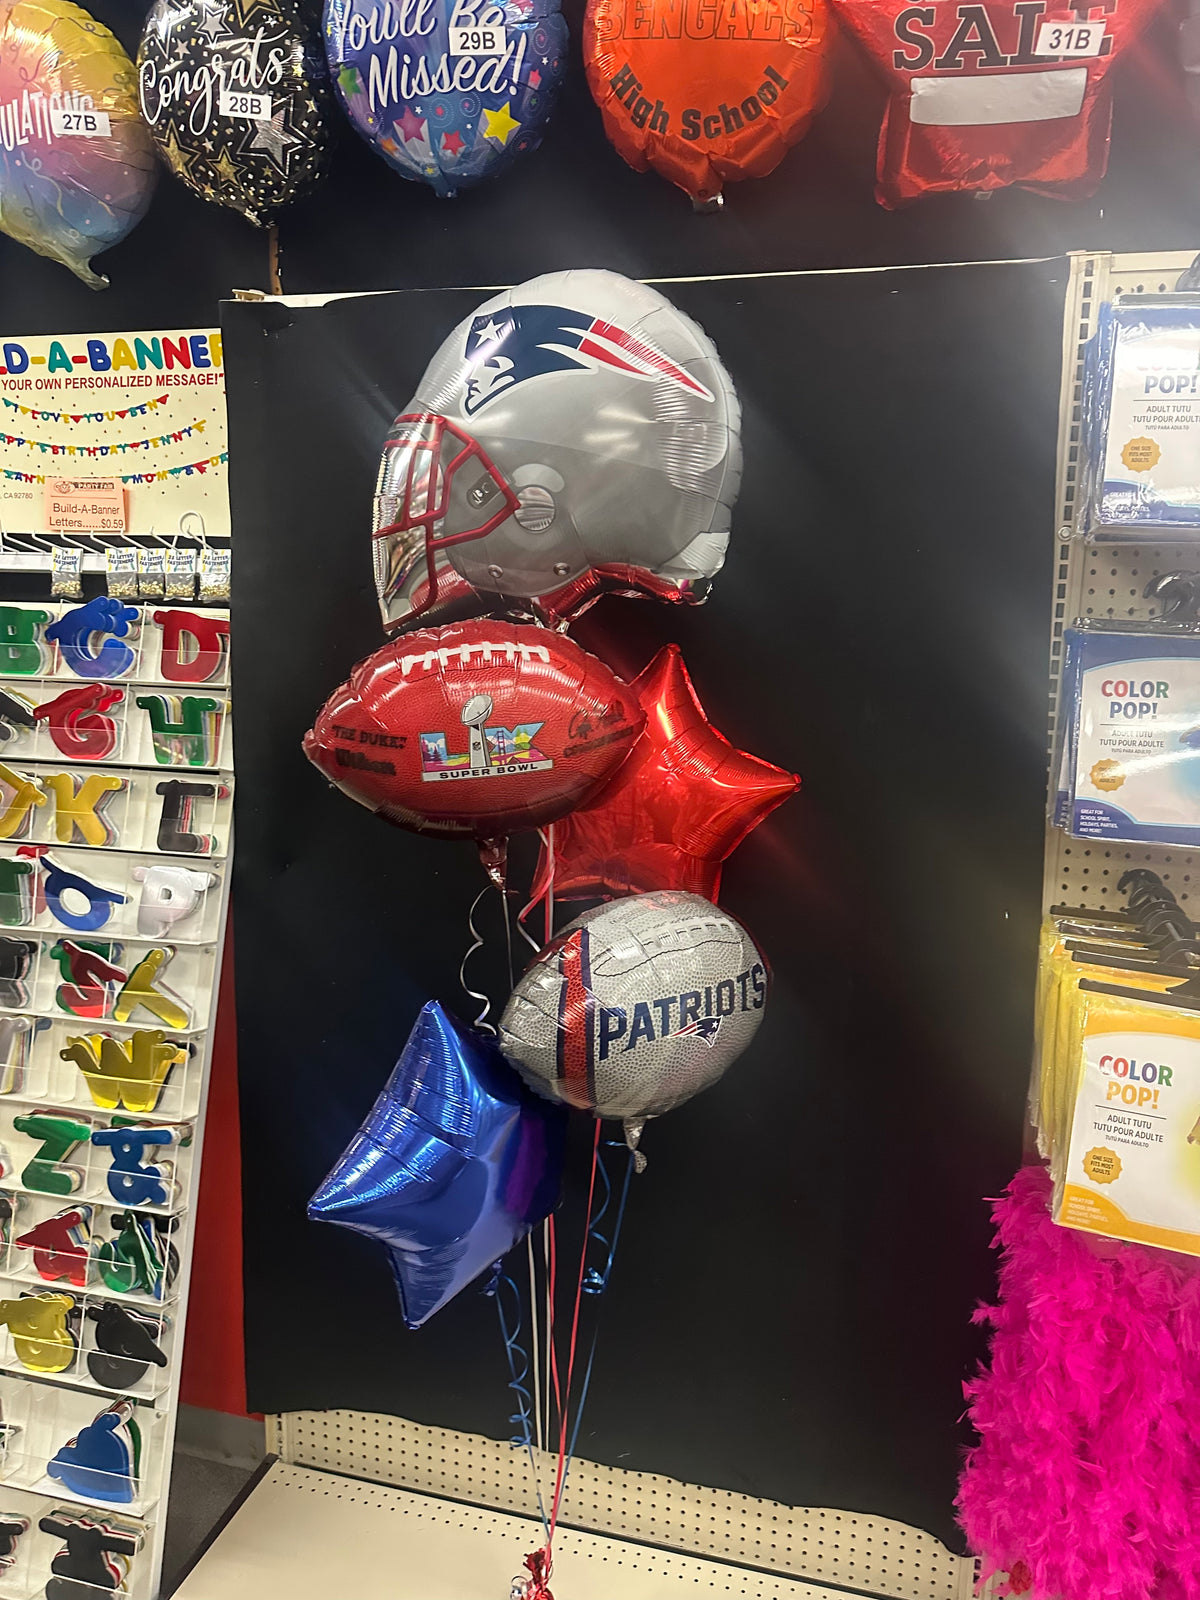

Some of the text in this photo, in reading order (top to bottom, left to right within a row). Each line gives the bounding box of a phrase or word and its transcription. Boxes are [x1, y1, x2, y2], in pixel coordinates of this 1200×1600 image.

[601, 0, 813, 43] BENGALS
[459, 31, 496, 50] 29B
[1049, 28, 1091, 50] 31B
[140, 26, 293, 136] Congrats
[369, 32, 527, 113] Missed!
[229, 96, 262, 115] 28B
[609, 62, 789, 141] High School
[62, 114, 97, 131] 27B
[2, 379, 33, 391] YOUR
[35, 378, 62, 390] OWN
[65, 375, 152, 389] PERSONALIZED
[1144, 374, 1198, 394] POP!
[31, 410, 71, 424] LOVE
[83, 410, 117, 423] YOU
[1146, 405, 1191, 413] ADULT TUTU
[1133, 415, 1152, 423] TUTU
[1153, 415, 1174, 423] POUR
[53, 503, 120, 515] Build-A-Banner
[1101, 680, 1169, 698] COLOR
[1109, 701, 1158, 719] POP!
[1118, 739, 1137, 747] POUR
[1138, 740, 1165, 748] ADULTE
[440, 763, 538, 779] SUPER BOWL
[598, 963, 765, 1061] PATRIOTS
[1099, 1055, 1173, 1087] COLOR
[1106, 1081, 1160, 1110] POP!
[1107, 1114, 1152, 1129] ADULT TUTU
[1093, 1122, 1164, 1143] TUTU POUR ADULTE
